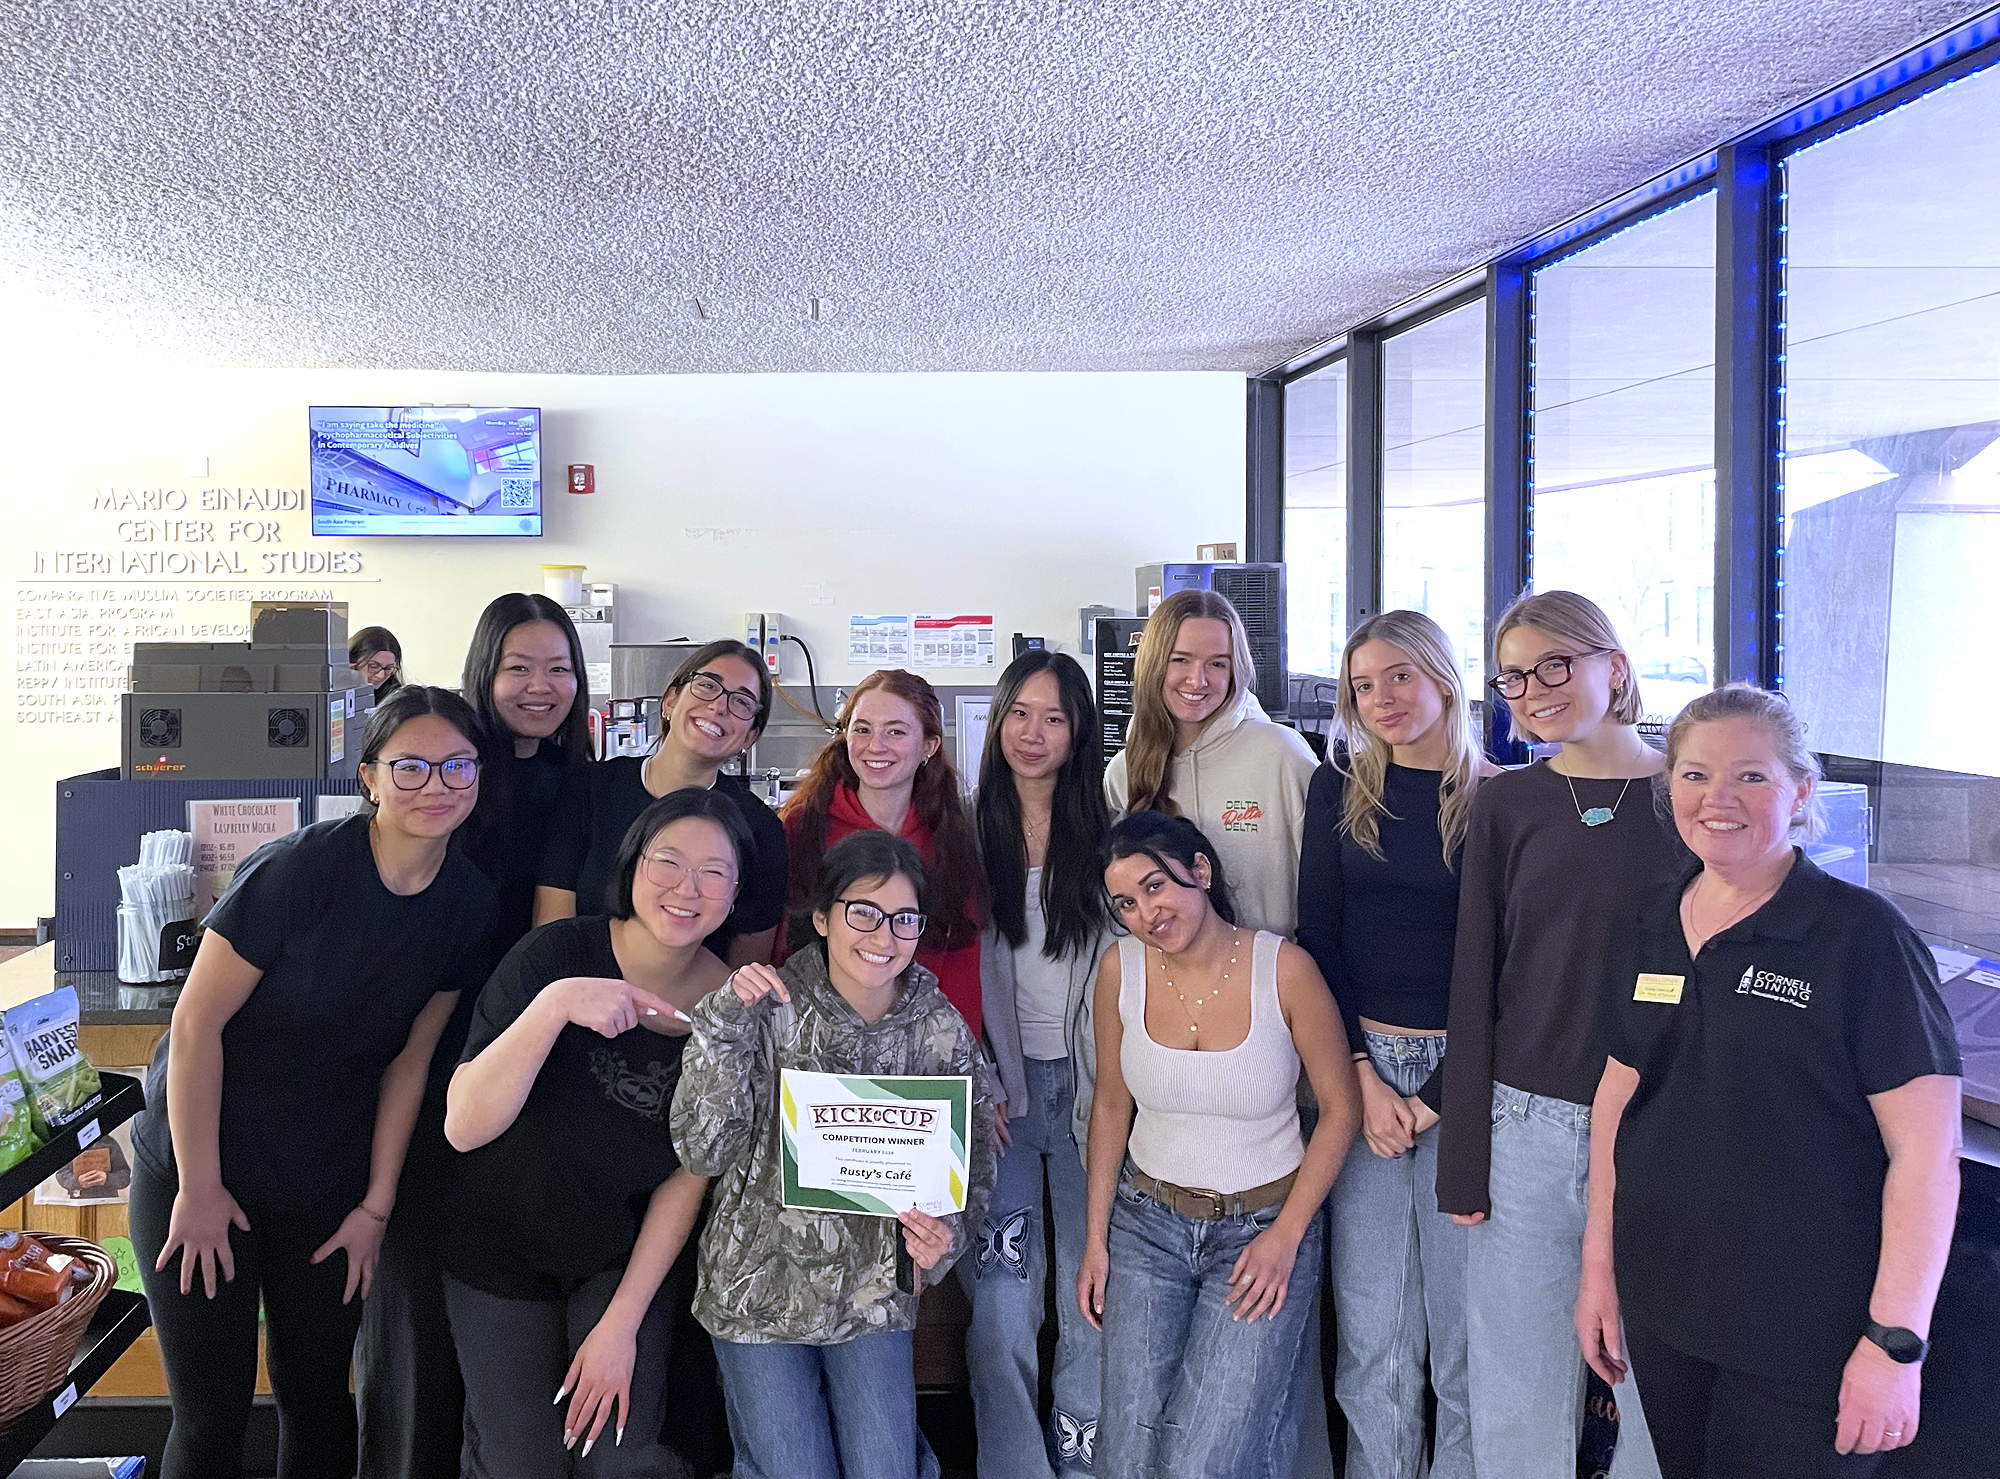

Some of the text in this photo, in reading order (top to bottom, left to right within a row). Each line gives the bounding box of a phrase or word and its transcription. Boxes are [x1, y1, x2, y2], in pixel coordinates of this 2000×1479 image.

[340, 421, 366, 431] saying
[366, 421, 384, 430] take
[385, 421, 399, 430] the
[317, 431, 458, 442] Psychopharmaceutical Subjectivities
[327, 441, 382, 452] Contemporary
[384, 441, 419, 450] Maldives
[93, 487, 306, 512] MARIO EINAUDI
[326, 477, 402, 509] PHARMACY
[118, 519, 282, 543] CENTER FOR
[33, 550, 363, 574] INTERNATIONAL STUDIES
[17, 588, 335, 602] COMPARATIVE MUSLIM SOCIETIES PROGRAM
[16, 607, 175, 620] EAST ASIA PROGRAM
[16, 625, 82, 637] INSTITUTE
[89, 625, 117, 637] FOR
[123, 625, 185, 637] AFRICAN
[16, 642, 82, 655] INSTITUTE
[89, 642, 117, 655] FOR
[16, 660, 57, 672] LATIN
[16, 677, 129, 690] REPPY INSTITUTE
[16, 694, 66, 706] SOUTH
[72, 694, 108, 706] ASIA
[16, 711, 101, 724] SOUTHEAST
[213, 803, 278, 817] WHITE CHOCOLATE
[1225, 800, 1259, 810] DELTA
[1221, 806, 1264, 825] Delta
[213, 822, 277, 834] RASPBERRY MOCHA
[1224, 822, 1258, 833] DELTA
[1756, 970, 1813, 993] CORNELL
[1753, 979, 1811, 1001] DINING
[812, 1106, 873, 1124] KICK
[882, 1108, 934, 1127] CUP
[822, 1133, 926, 1146] COMPETITION WINNER
[840, 1166, 912, 1181] Rusty's Café
